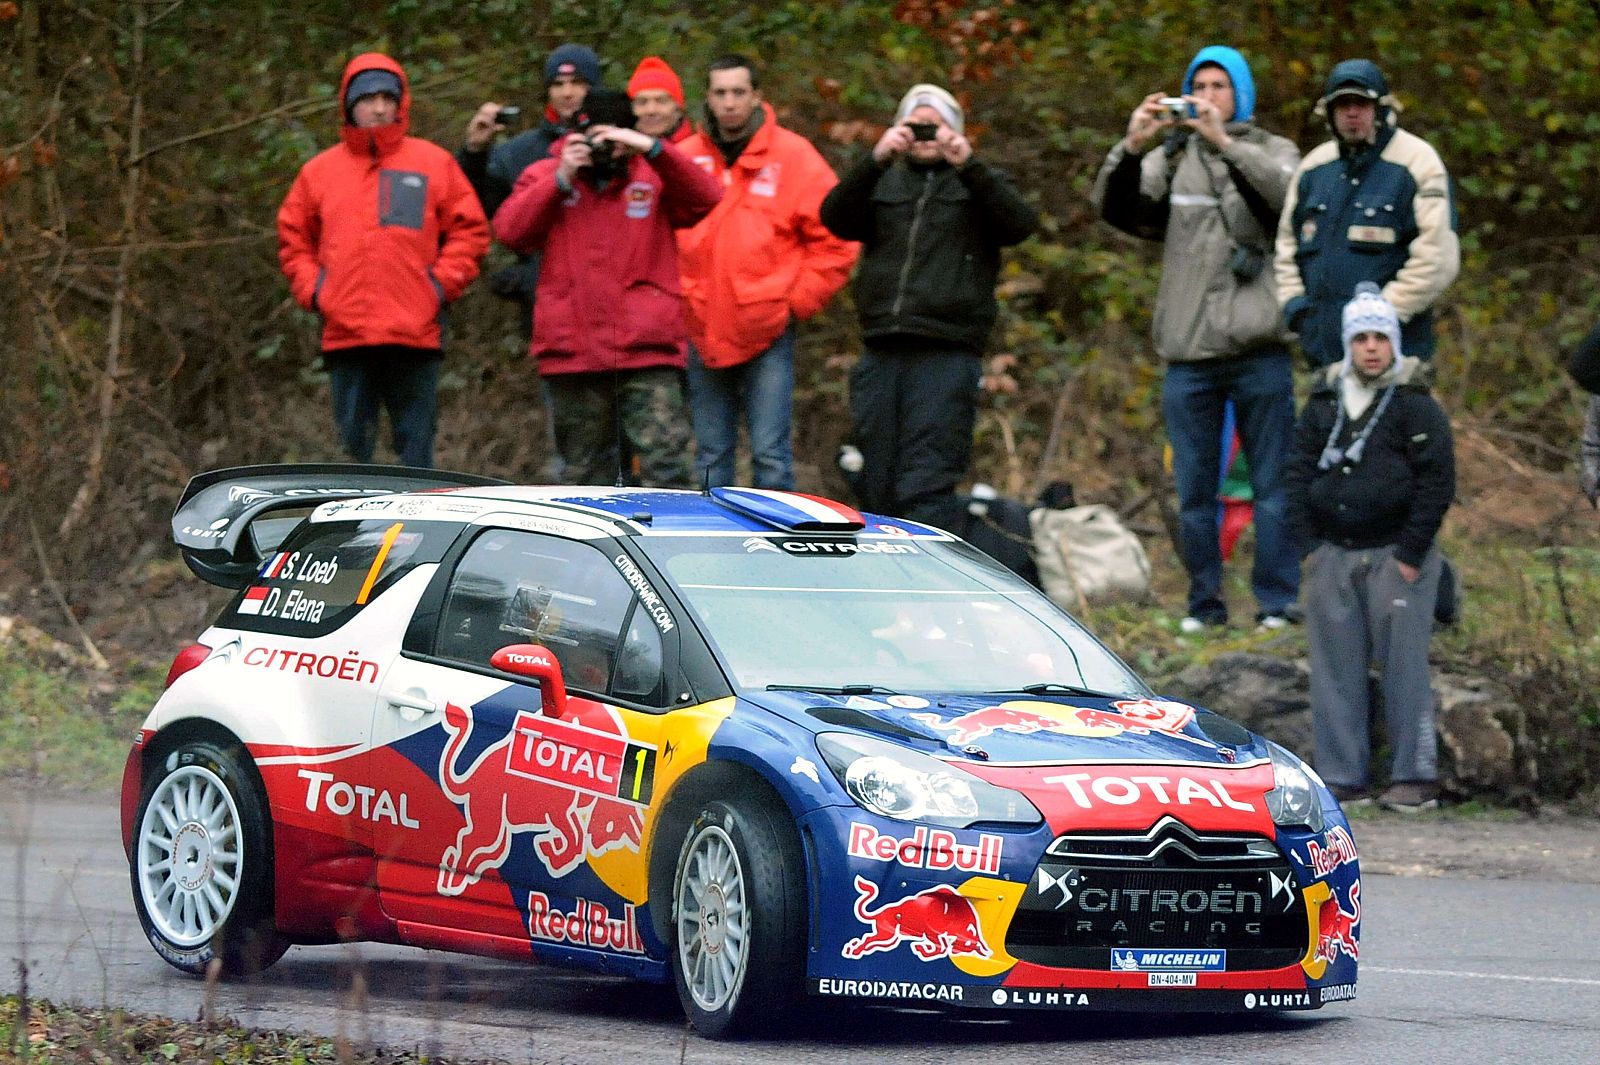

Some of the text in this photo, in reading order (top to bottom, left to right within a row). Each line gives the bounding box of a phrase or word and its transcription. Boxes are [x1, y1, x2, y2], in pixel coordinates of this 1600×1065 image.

[281, 551, 338, 585] S. Loeb
[356, 522, 404, 605] 1
[261, 587, 325, 624] D. Elena
[506, 653, 551, 666] TOTAL
[520, 727, 615, 783] TOTAL
[632, 748, 648, 801] 1
[297, 768, 420, 829] TOTAL
[1042, 773, 1256, 813] TOTAL
[1140, 953, 1221, 965] MICHELIN
[818, 978, 963, 1000] EURODATACAR
[1150, 974, 1194, 985] BN-404-MV
[1012, 990, 1090, 1005] LUHTA
[1259, 993, 1310, 1006] LUHTA
